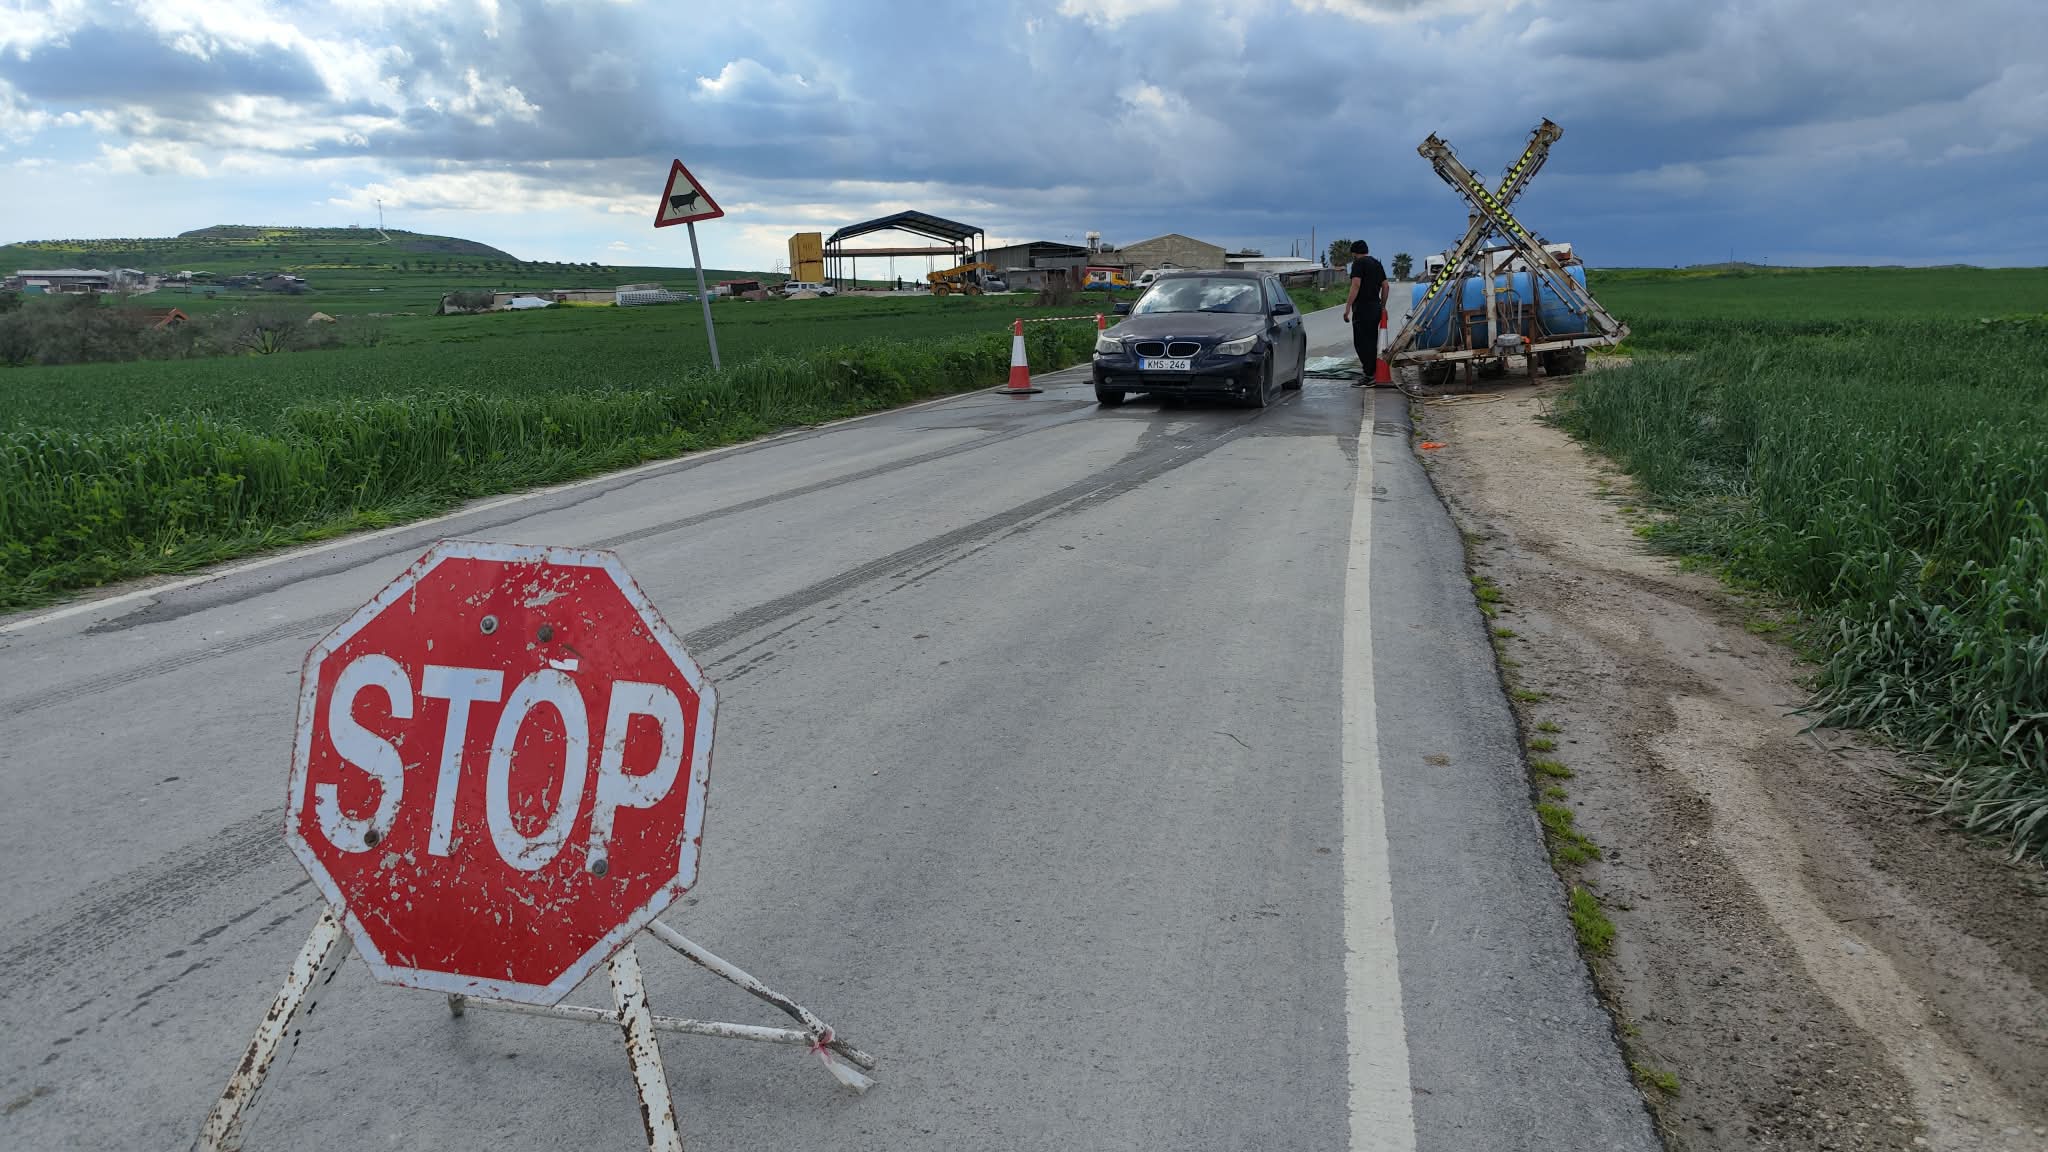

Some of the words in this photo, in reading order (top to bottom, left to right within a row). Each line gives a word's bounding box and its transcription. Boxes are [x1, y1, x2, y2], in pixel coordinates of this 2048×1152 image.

[1148, 360, 1164, 369] KMS
[1169, 360, 1185, 369] 246
[314, 653, 685, 875] STOP
